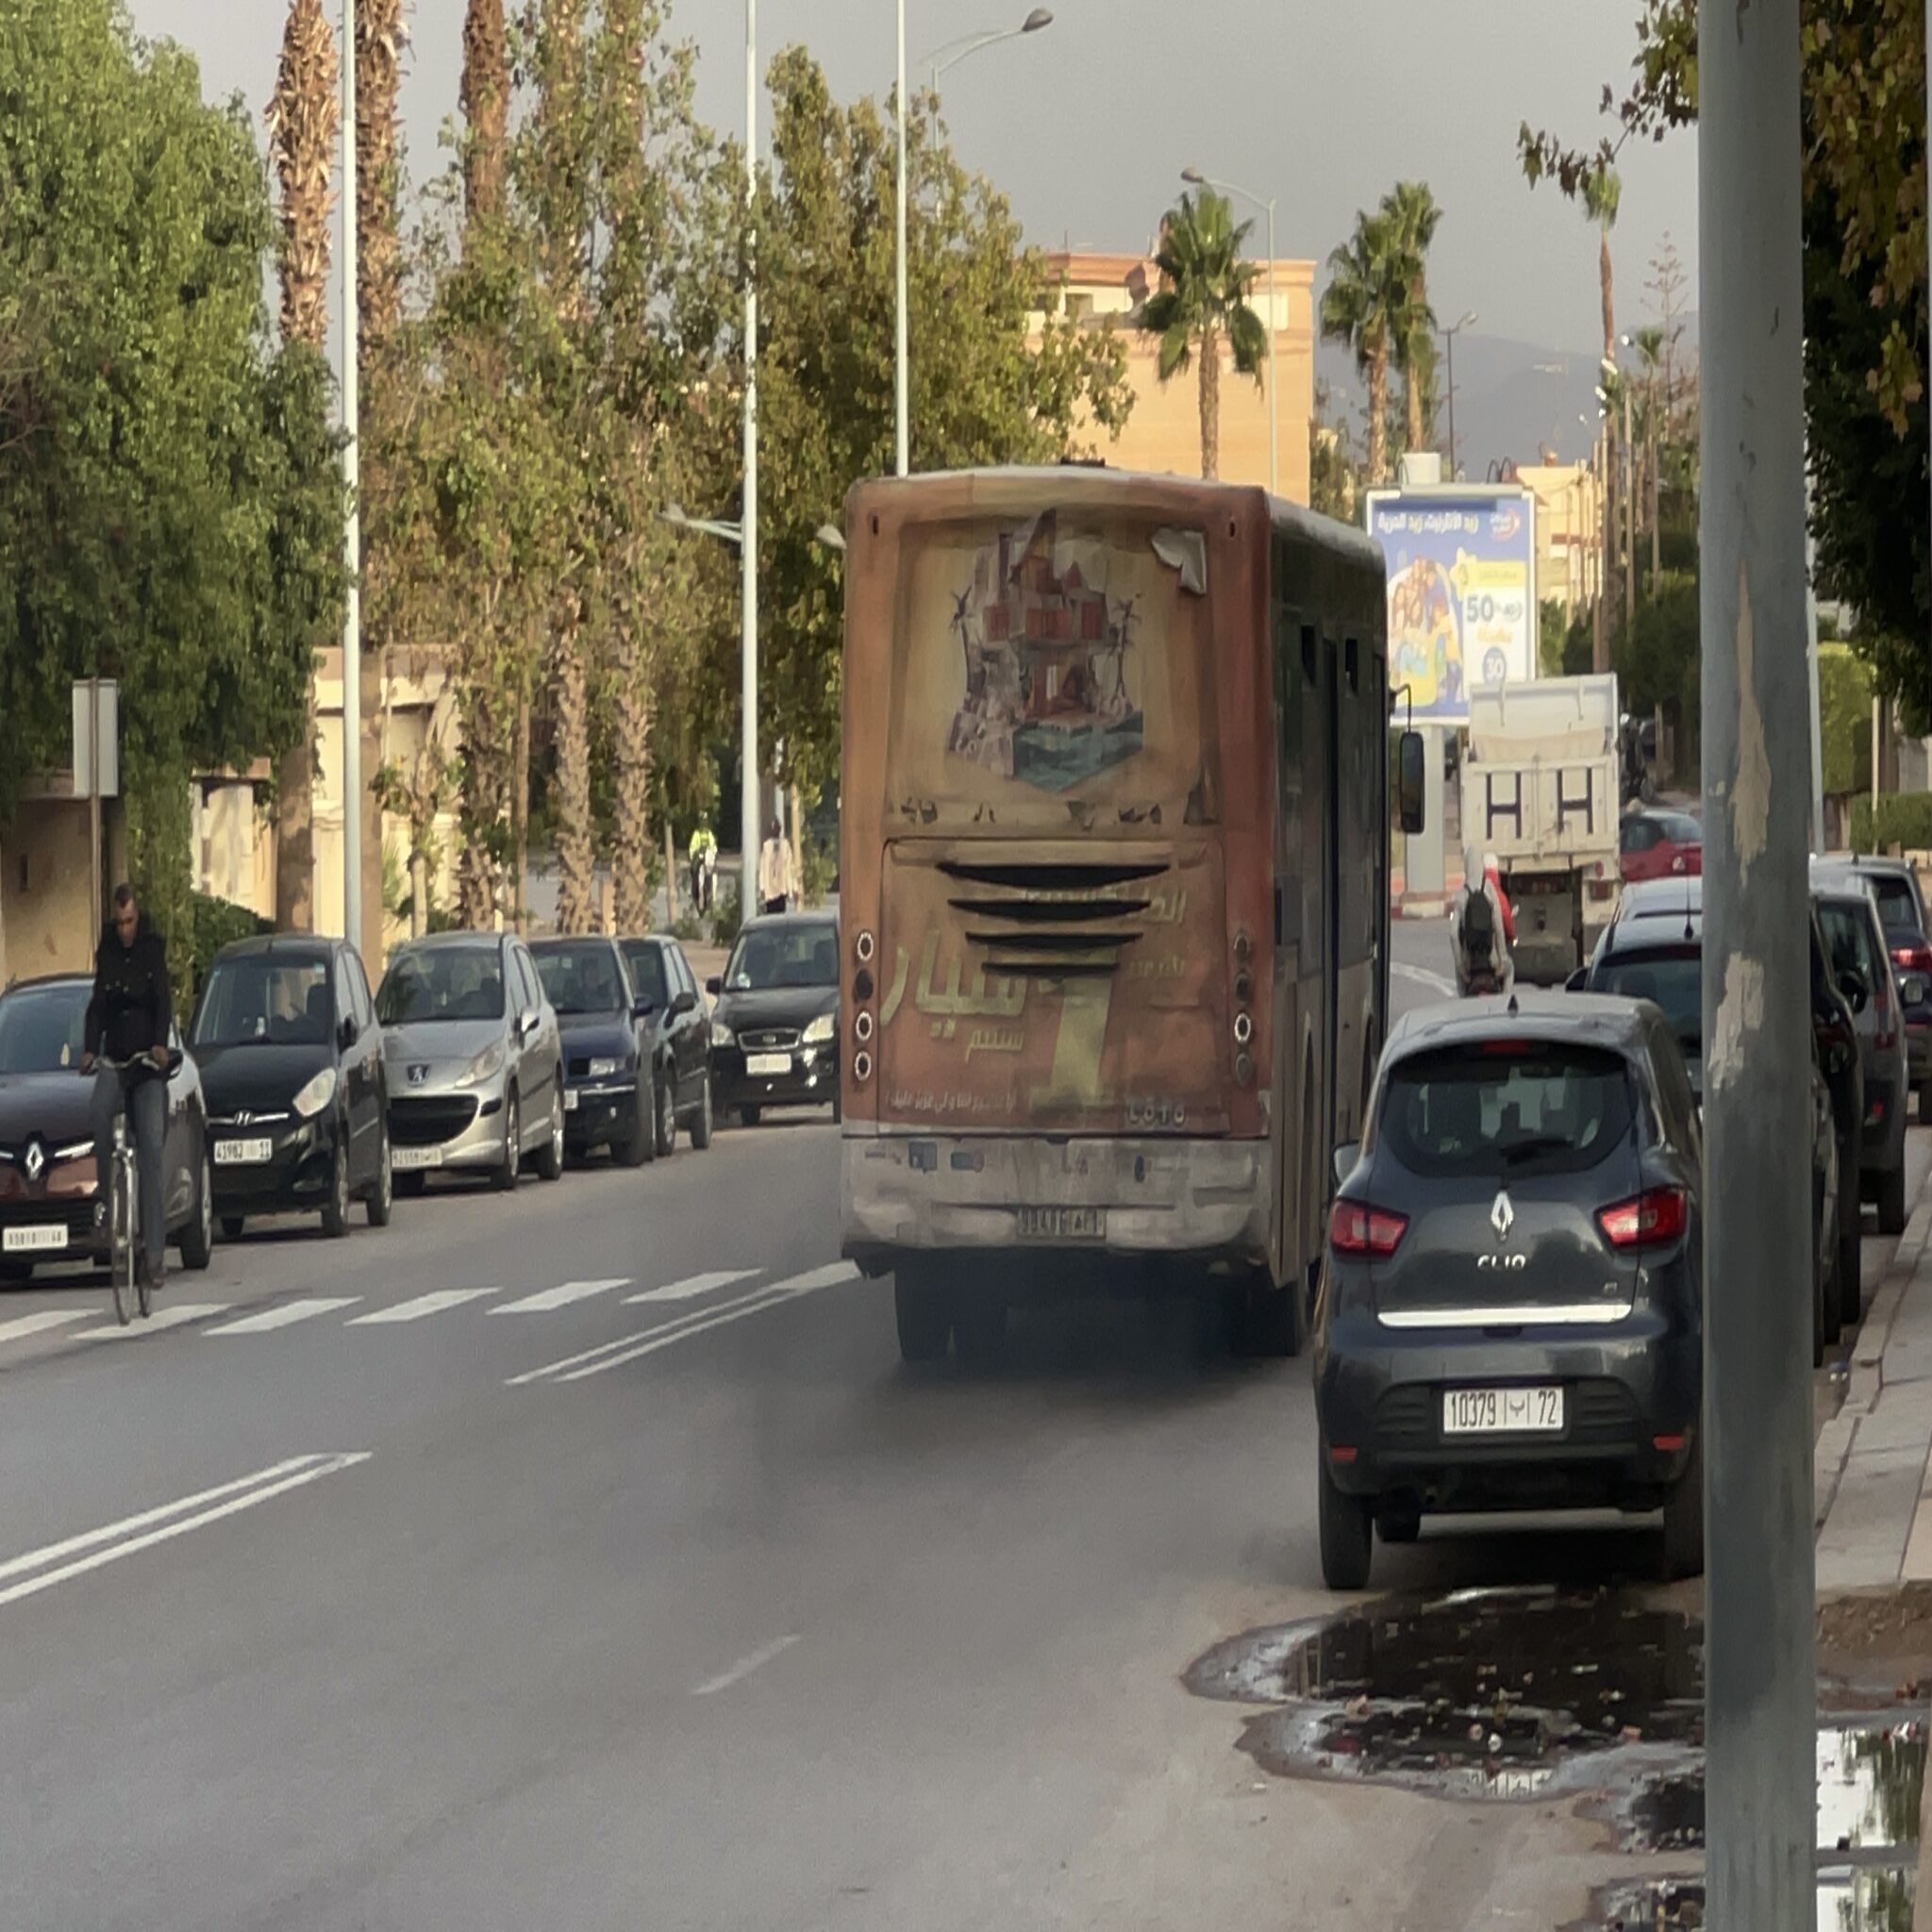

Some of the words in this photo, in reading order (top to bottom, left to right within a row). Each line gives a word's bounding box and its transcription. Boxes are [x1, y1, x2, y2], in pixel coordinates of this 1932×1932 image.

[1467, 593, 1494, 623] 50
[1477, 1254, 1526, 1270] CLIO
[1452, 1392, 1496, 1428] 10379
[1538, 1390, 1557, 1425] 72
